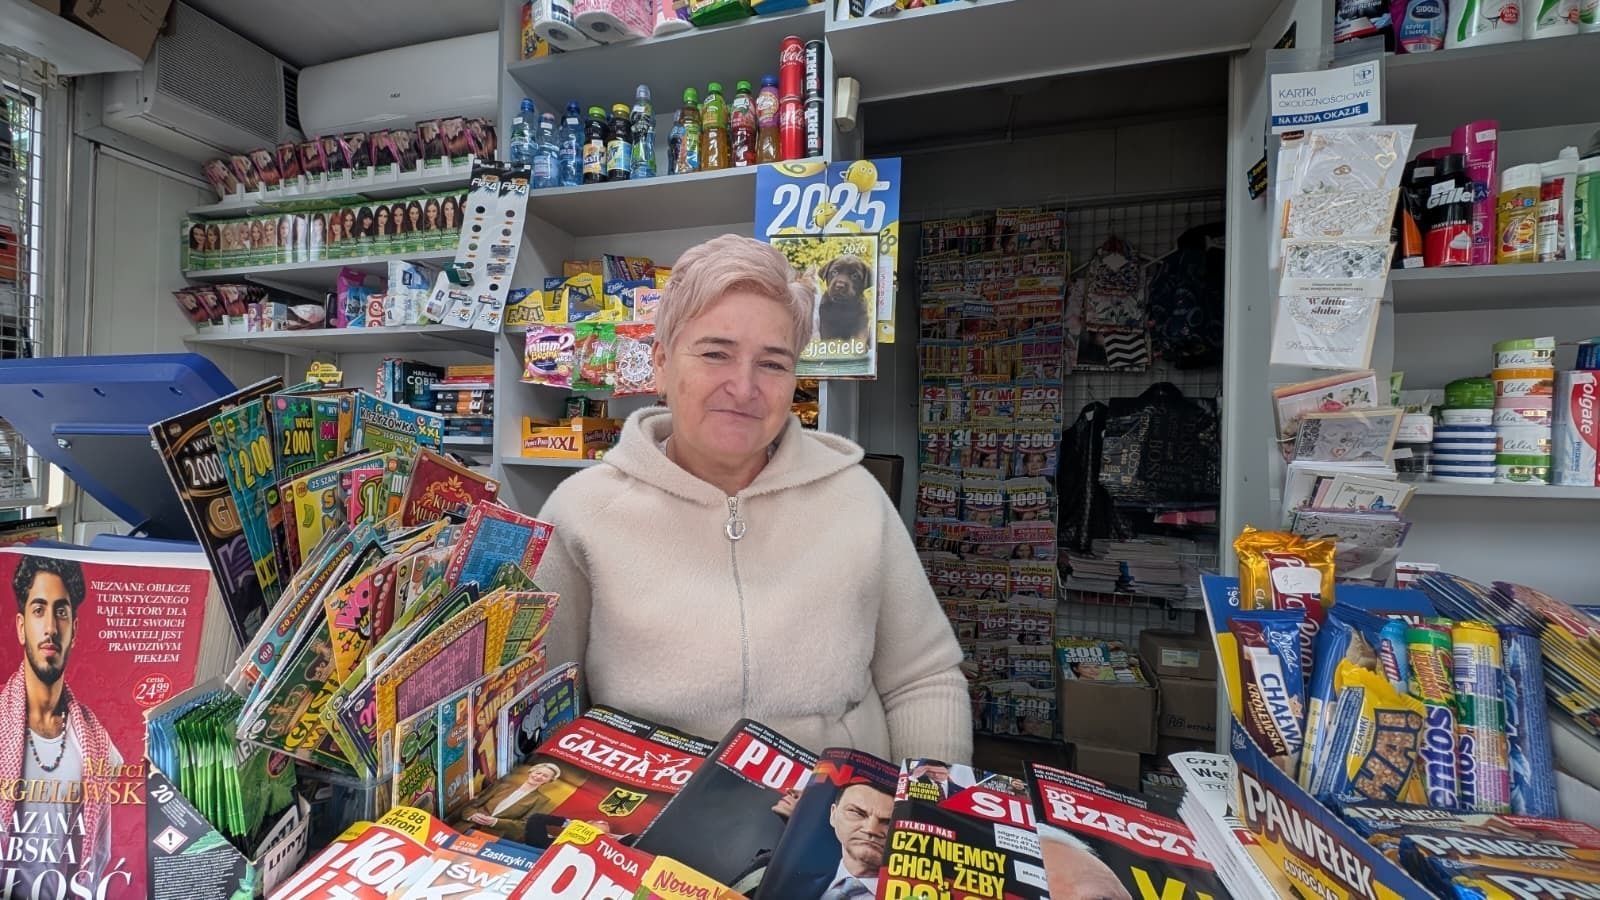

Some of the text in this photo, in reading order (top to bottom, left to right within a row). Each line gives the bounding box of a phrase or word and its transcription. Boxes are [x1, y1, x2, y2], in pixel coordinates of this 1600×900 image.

[1279, 87, 1317, 98] KARTKI
[1279, 89, 1372, 108] OKOLICZNOŚCIOWE
[1278, 106, 1361, 125] NA KAŻDĄ OKAZJĘ
[766, 181, 891, 237] 2025
[843, 242, 867, 254] 2026
[1306, 296, 1347, 306] W dniu
[1504, 383, 1533, 394] Celia
[418, 425, 442, 440] XXL
[1020, 433, 1055, 448] 500
[549, 436, 579, 452] XXL
[1504, 439, 1534, 450] Celia
[920, 487, 957, 503] 1500
[965, 492, 1003, 506] 2000
[1010, 492, 1047, 506] 1000
[90, 580, 191, 593] NIEZNANE OBLICZE
[97, 593, 189, 605] TURYSTYCZNEGO
[290, 594, 311, 619] SZANS
[309, 582, 319, 594] NA
[97, 604, 187, 617] RAJU, KTÓRY DLA
[106, 617, 185, 628] WIELU SWOICH
[98, 630, 183, 641] OBYWATELI JEST
[108, 641, 181, 652] PRAWDZIWYM
[1064, 646, 1103, 658] 300
[134, 654, 179, 663] PIEKŁEM
[1065, 656, 1106, 664] SUDOKU
[1260, 672, 1304, 755] CHAŁWA
[1351, 715, 1369, 755] SEZAMKI
[558, 733, 648, 778] GAZETA
[1186, 757, 1217, 767] Czy
[82, 756, 146, 779] Marci
[150, 784, 175, 807] 20
[1045, 789, 1076, 804] DO
[392, 809, 427, 826] Aż 88
[383, 816, 421, 837] stron!
[899, 820, 953, 839] TYLKO U NAS
[1049, 798, 1206, 861] RZECZY
[1241, 771, 1378, 900] PAWEŁEK
[892, 831, 1007, 875] CZY NIEMCY
[1405, 834, 1578, 862] PAWEŁEK
[481, 848, 526, 869] Zastrzyki
[596, 839, 641, 877] TWOJA
[653, 869, 720, 900] Nowa!
[888, 853, 1006, 900] CHCĄ, ŻEBY
